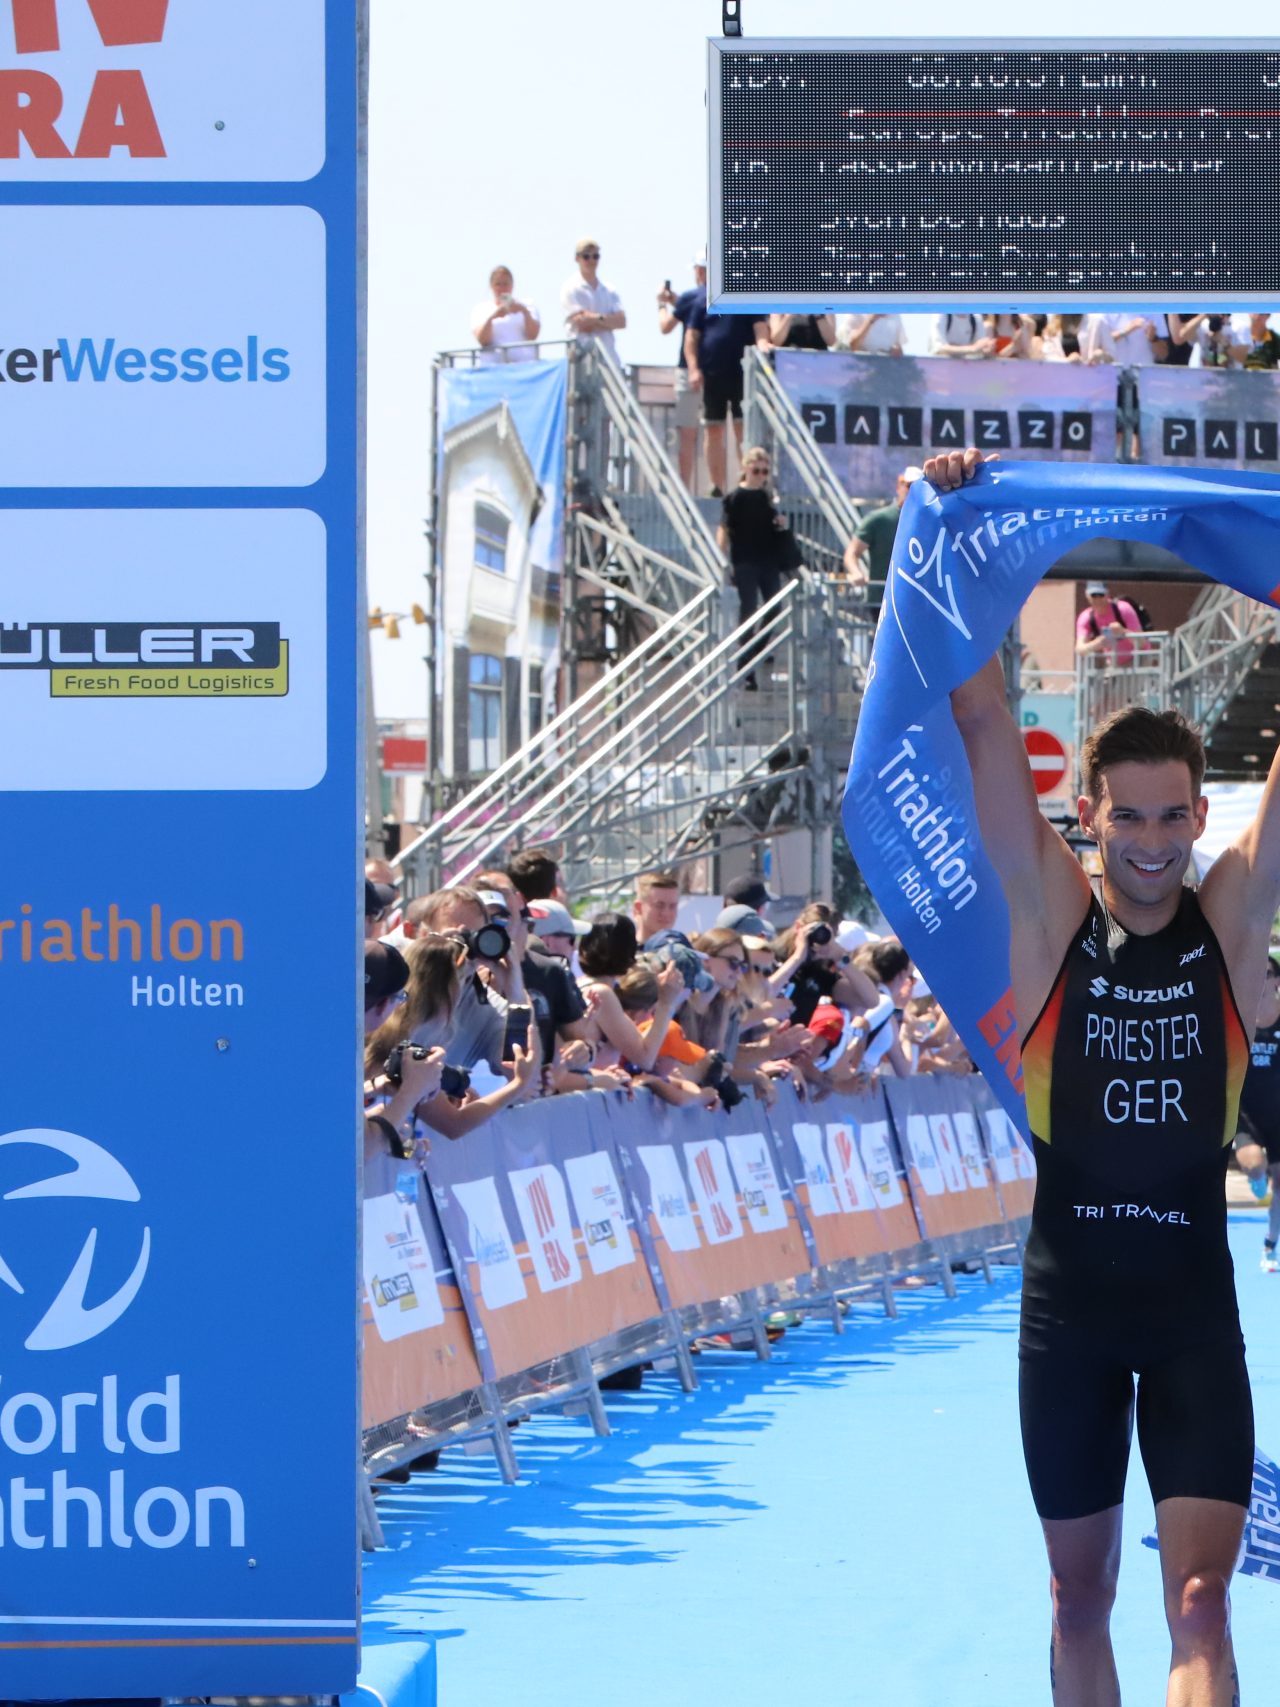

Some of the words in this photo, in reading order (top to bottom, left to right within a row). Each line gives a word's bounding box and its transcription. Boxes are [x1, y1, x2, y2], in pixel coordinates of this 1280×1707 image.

[0, 336, 291, 383] erWessels
[807, 409, 1087, 442] PALAZZO
[1074, 512, 1167, 529] Holten
[64, 675, 120, 691] Fresh
[128, 675, 179, 691] Food
[187, 675, 275, 693] Logistics
[877, 738, 978, 911] Triathlon
[897, 864, 942, 935] Holten
[131, 975, 245, 1007] Holten
[1112, 980, 1195, 1003] SUZUKI
[1085, 1012, 1203, 1063] PRIESTER
[1103, 1077, 1189, 1124] GER
[1073, 1205, 1104, 1219] TRI
[1111, 1203, 1191, 1225] TRAVEL
[0, 1374, 181, 1455] orld
[0, 1469, 246, 1549] thlon
